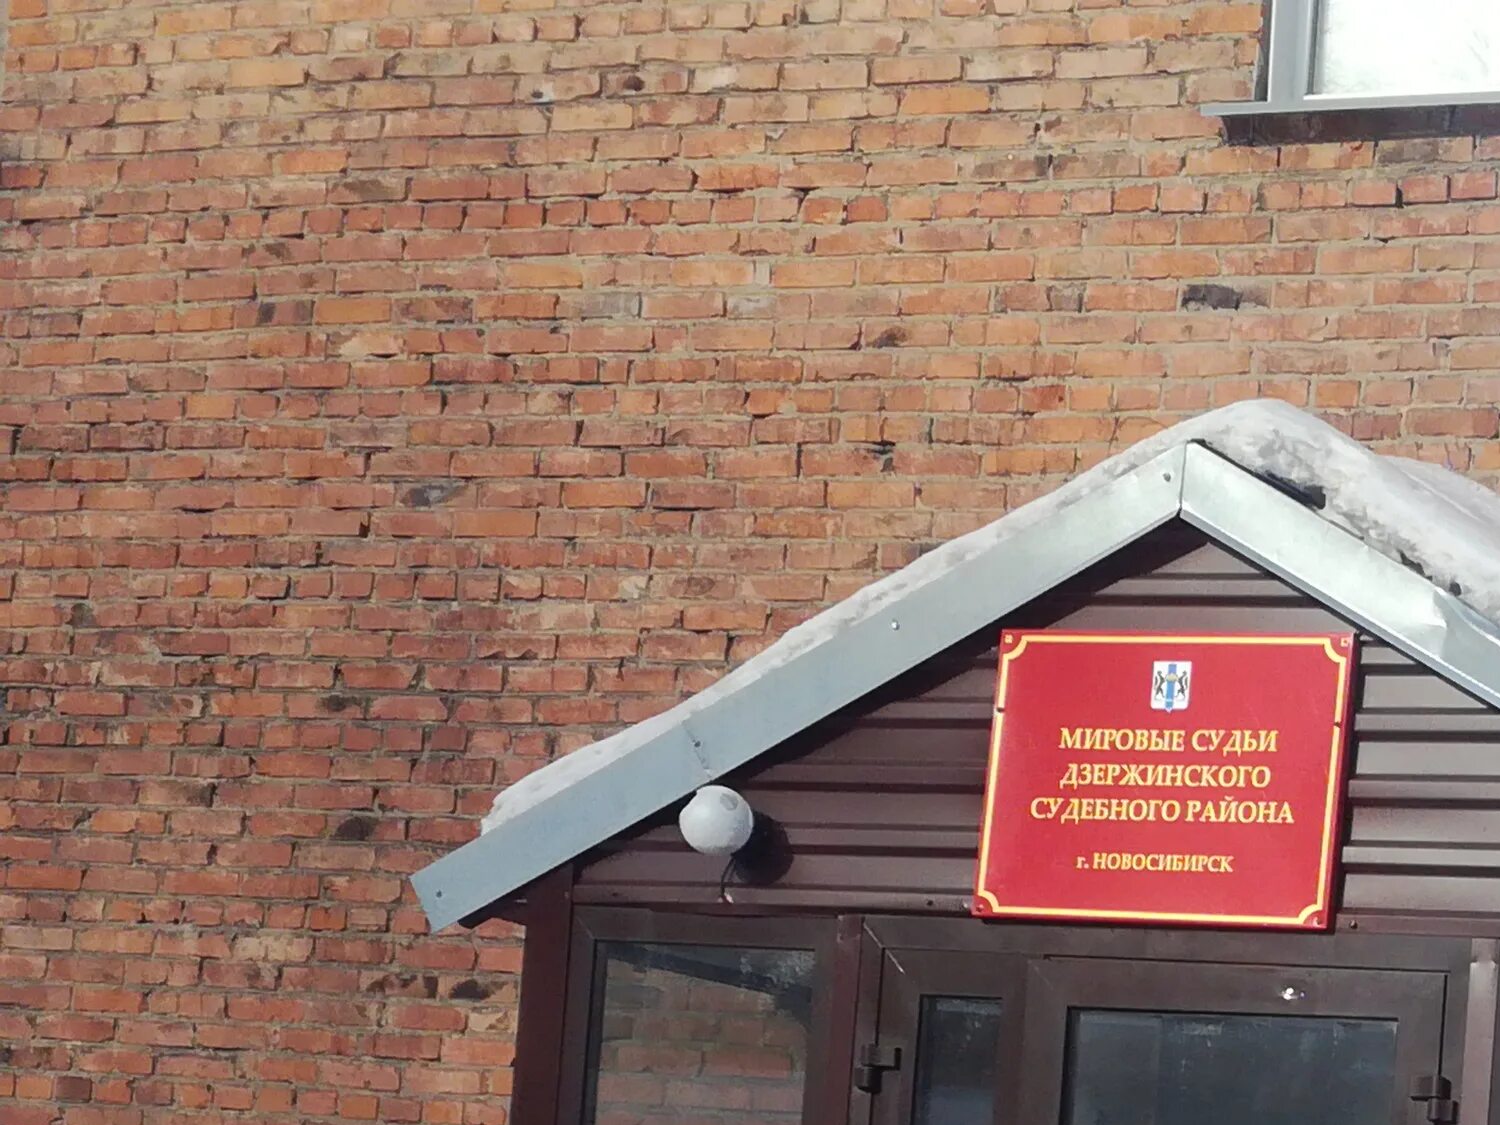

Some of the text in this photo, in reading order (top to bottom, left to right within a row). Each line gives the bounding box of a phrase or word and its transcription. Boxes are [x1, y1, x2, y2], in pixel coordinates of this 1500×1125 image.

[1059, 727, 1278, 757] МИРОВЫЕ СУДЬИ
[1059, 763, 1271, 788] ДЗЕРЖИНСКОГО
[1030, 796, 1294, 824] СУДЕБНОГО РАЙОНА
[1076, 853, 1233, 872] г. НОВОСИБИРСК
